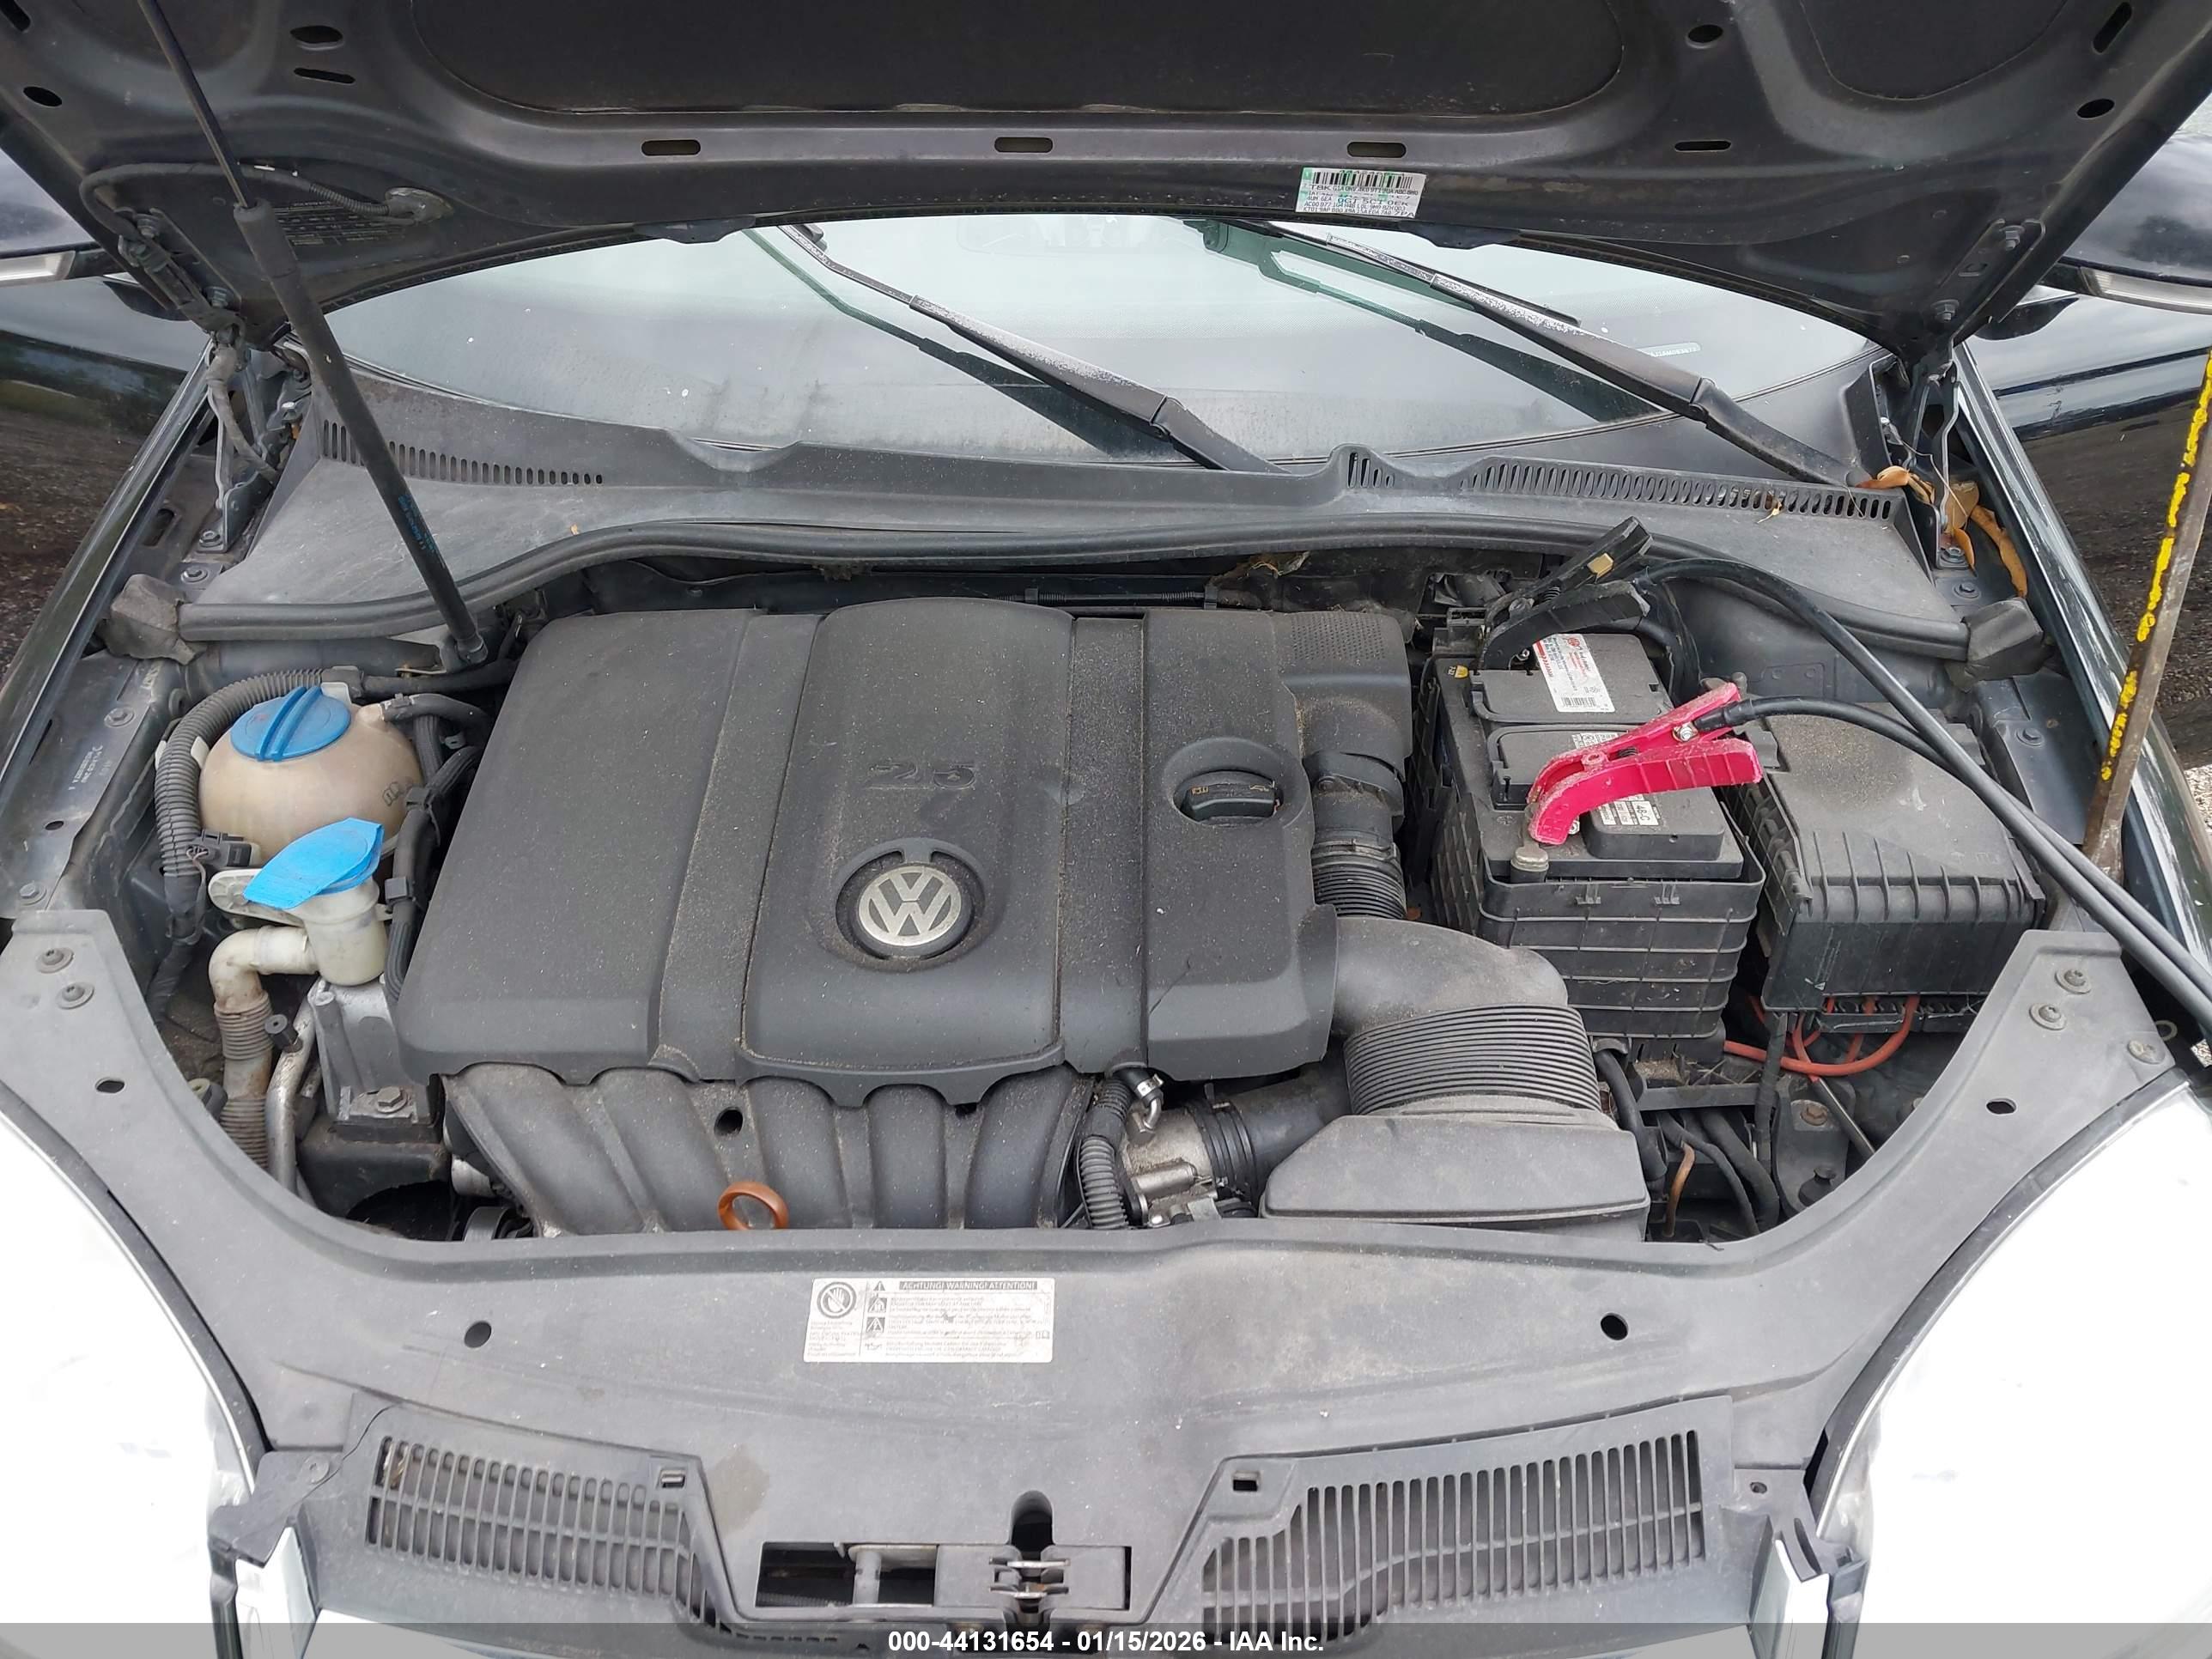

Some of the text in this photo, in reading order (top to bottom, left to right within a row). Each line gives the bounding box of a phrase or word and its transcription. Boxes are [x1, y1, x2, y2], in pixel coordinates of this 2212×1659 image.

[860, 866, 960, 945] VW
[902, 1281, 1036, 1291] ACHTUNG! WARNING! ATTENTION!
